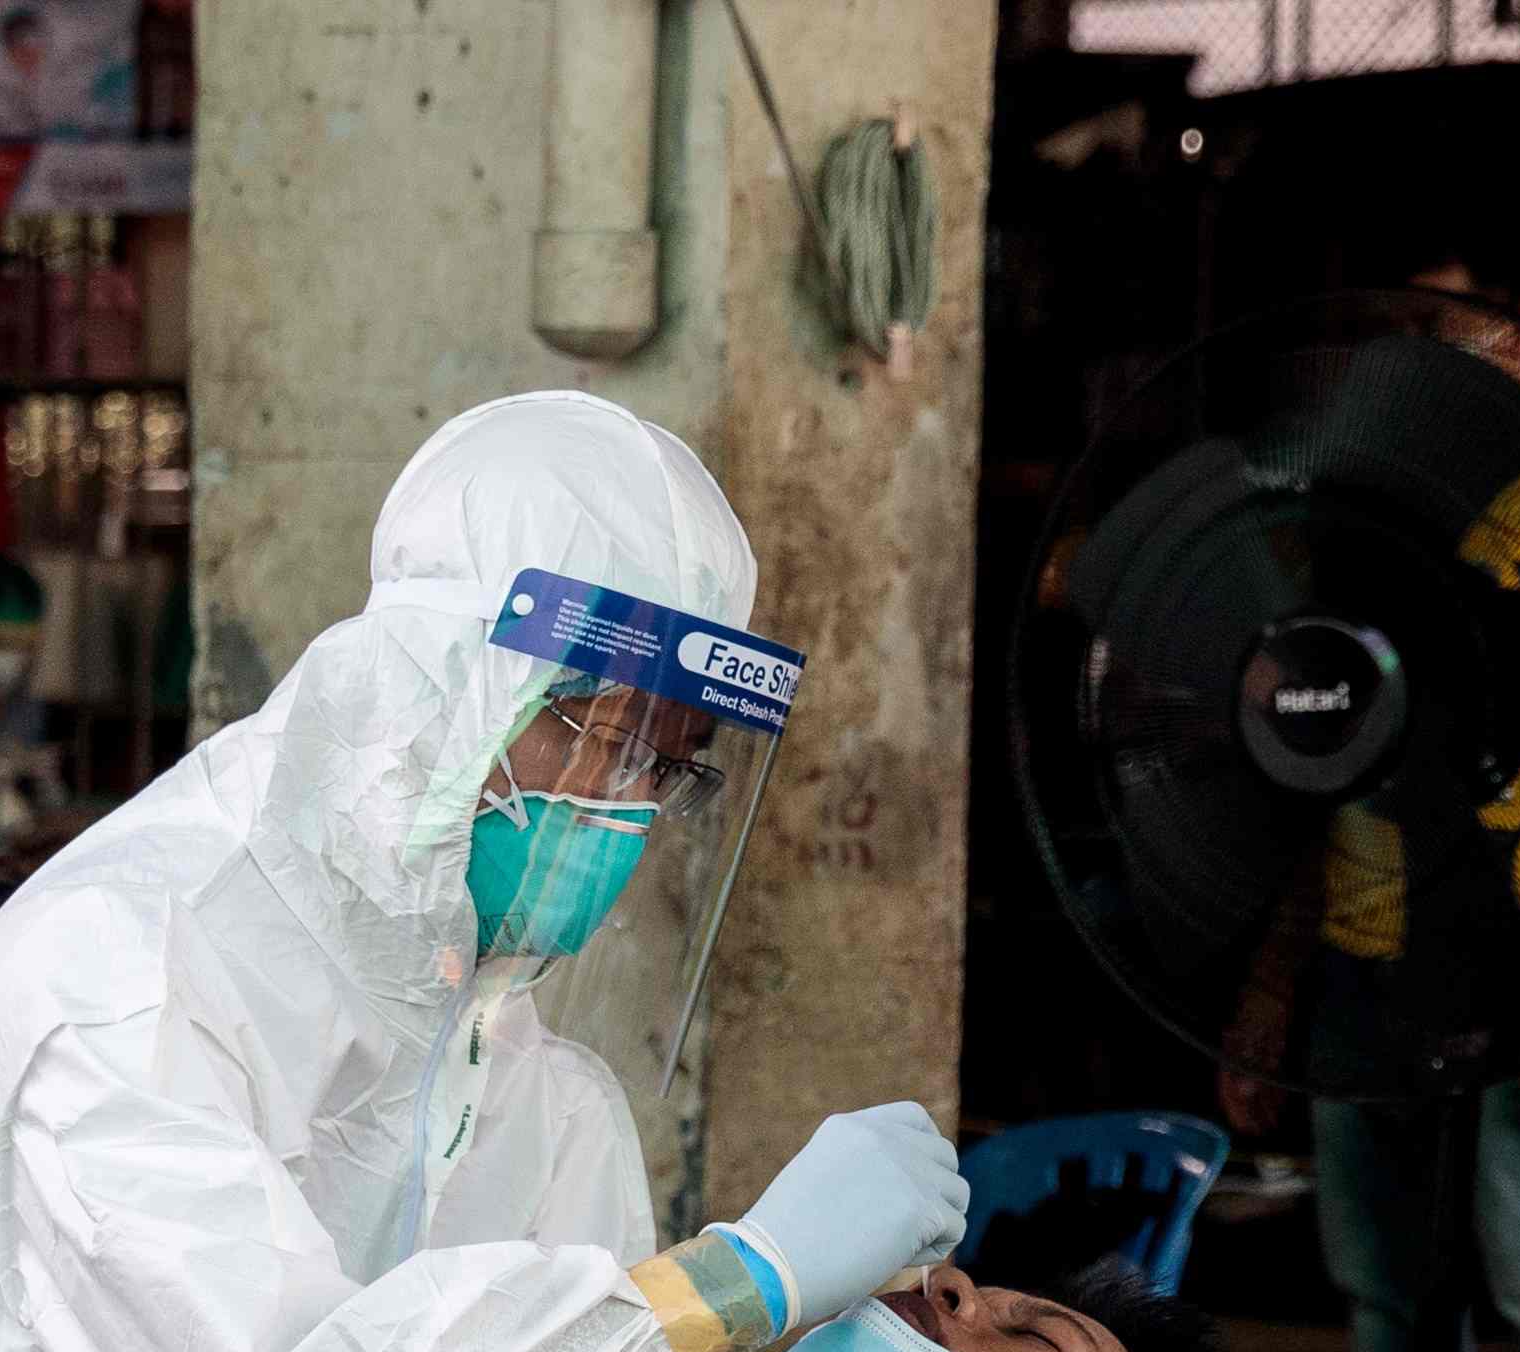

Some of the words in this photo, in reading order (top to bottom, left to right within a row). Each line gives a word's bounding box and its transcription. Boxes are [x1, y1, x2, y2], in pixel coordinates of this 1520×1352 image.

[704, 642, 765, 688] Face
[701, 686, 738, 710] Direct
[738, 698, 769, 721] Splash
